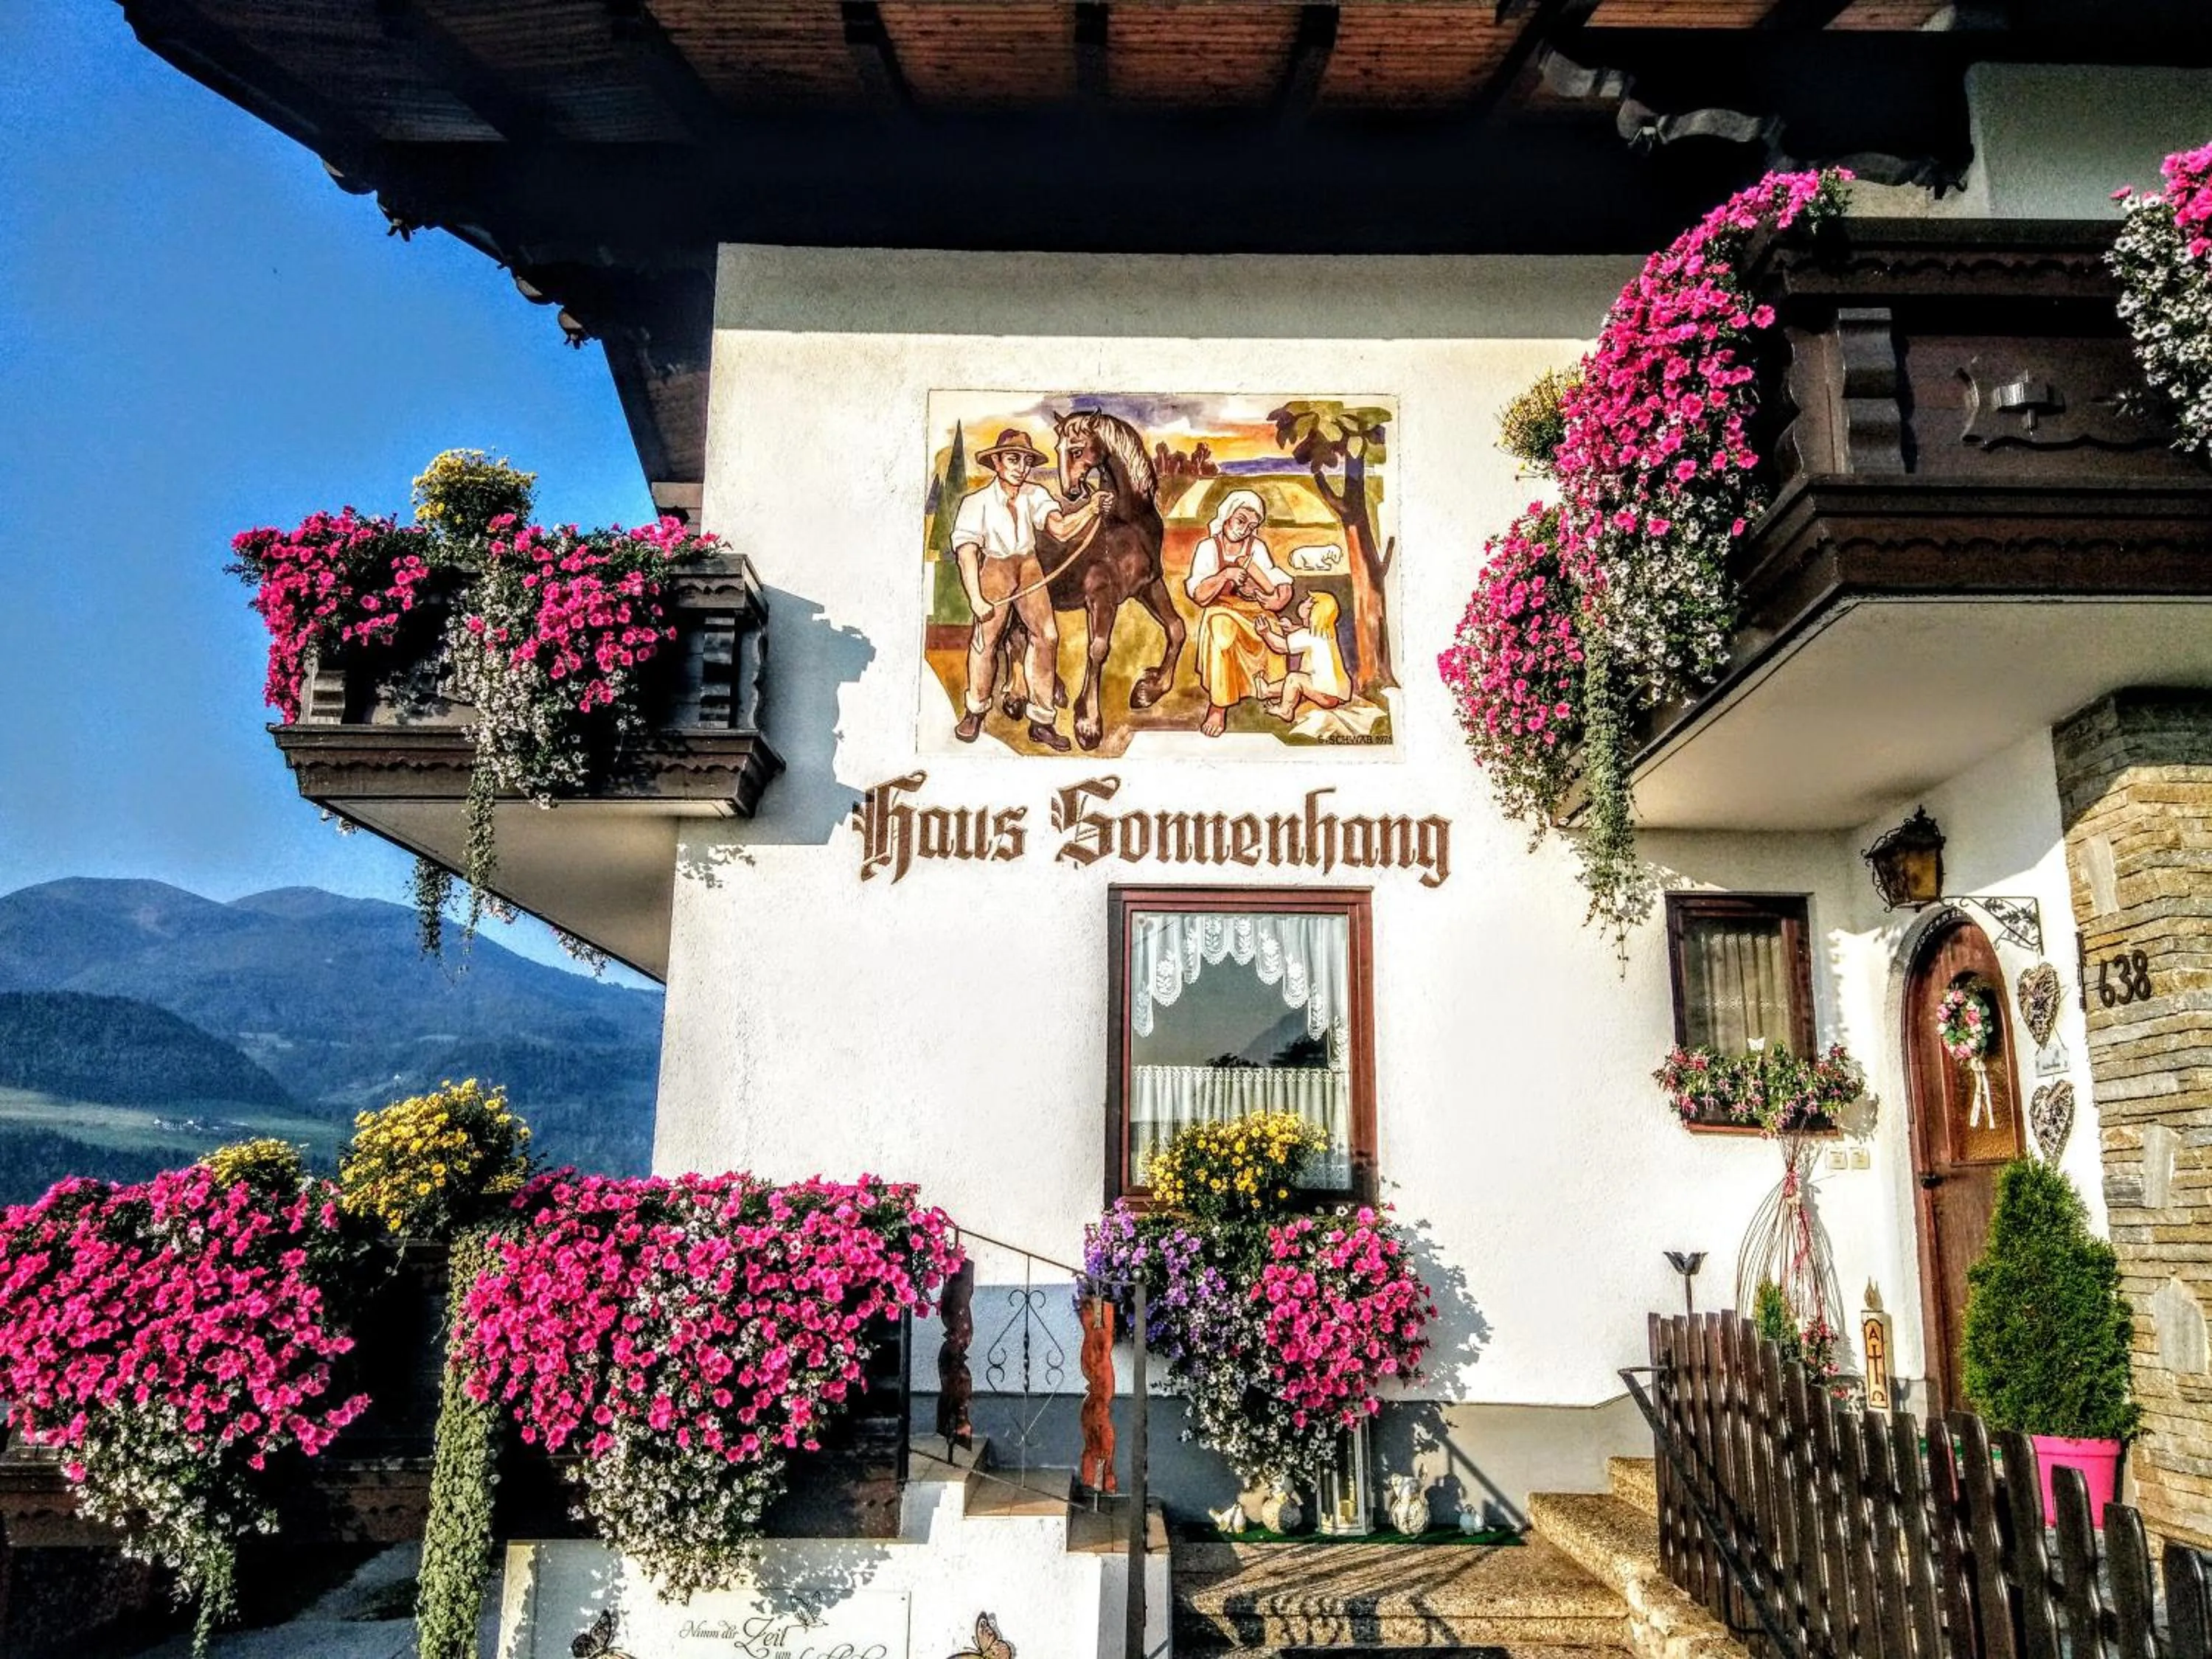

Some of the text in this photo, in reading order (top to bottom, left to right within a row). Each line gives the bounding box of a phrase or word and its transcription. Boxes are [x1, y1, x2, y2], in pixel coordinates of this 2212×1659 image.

[852, 769, 1450, 888] Haus Sonnenhang
[2100, 950, 2152, 1008] 638
[1868, 1327, 1879, 1341] A
[679, 1621, 718, 1638] Nimm
[718, 1621, 739, 1638] dir
[734, 1617, 798, 1659] Zeit
